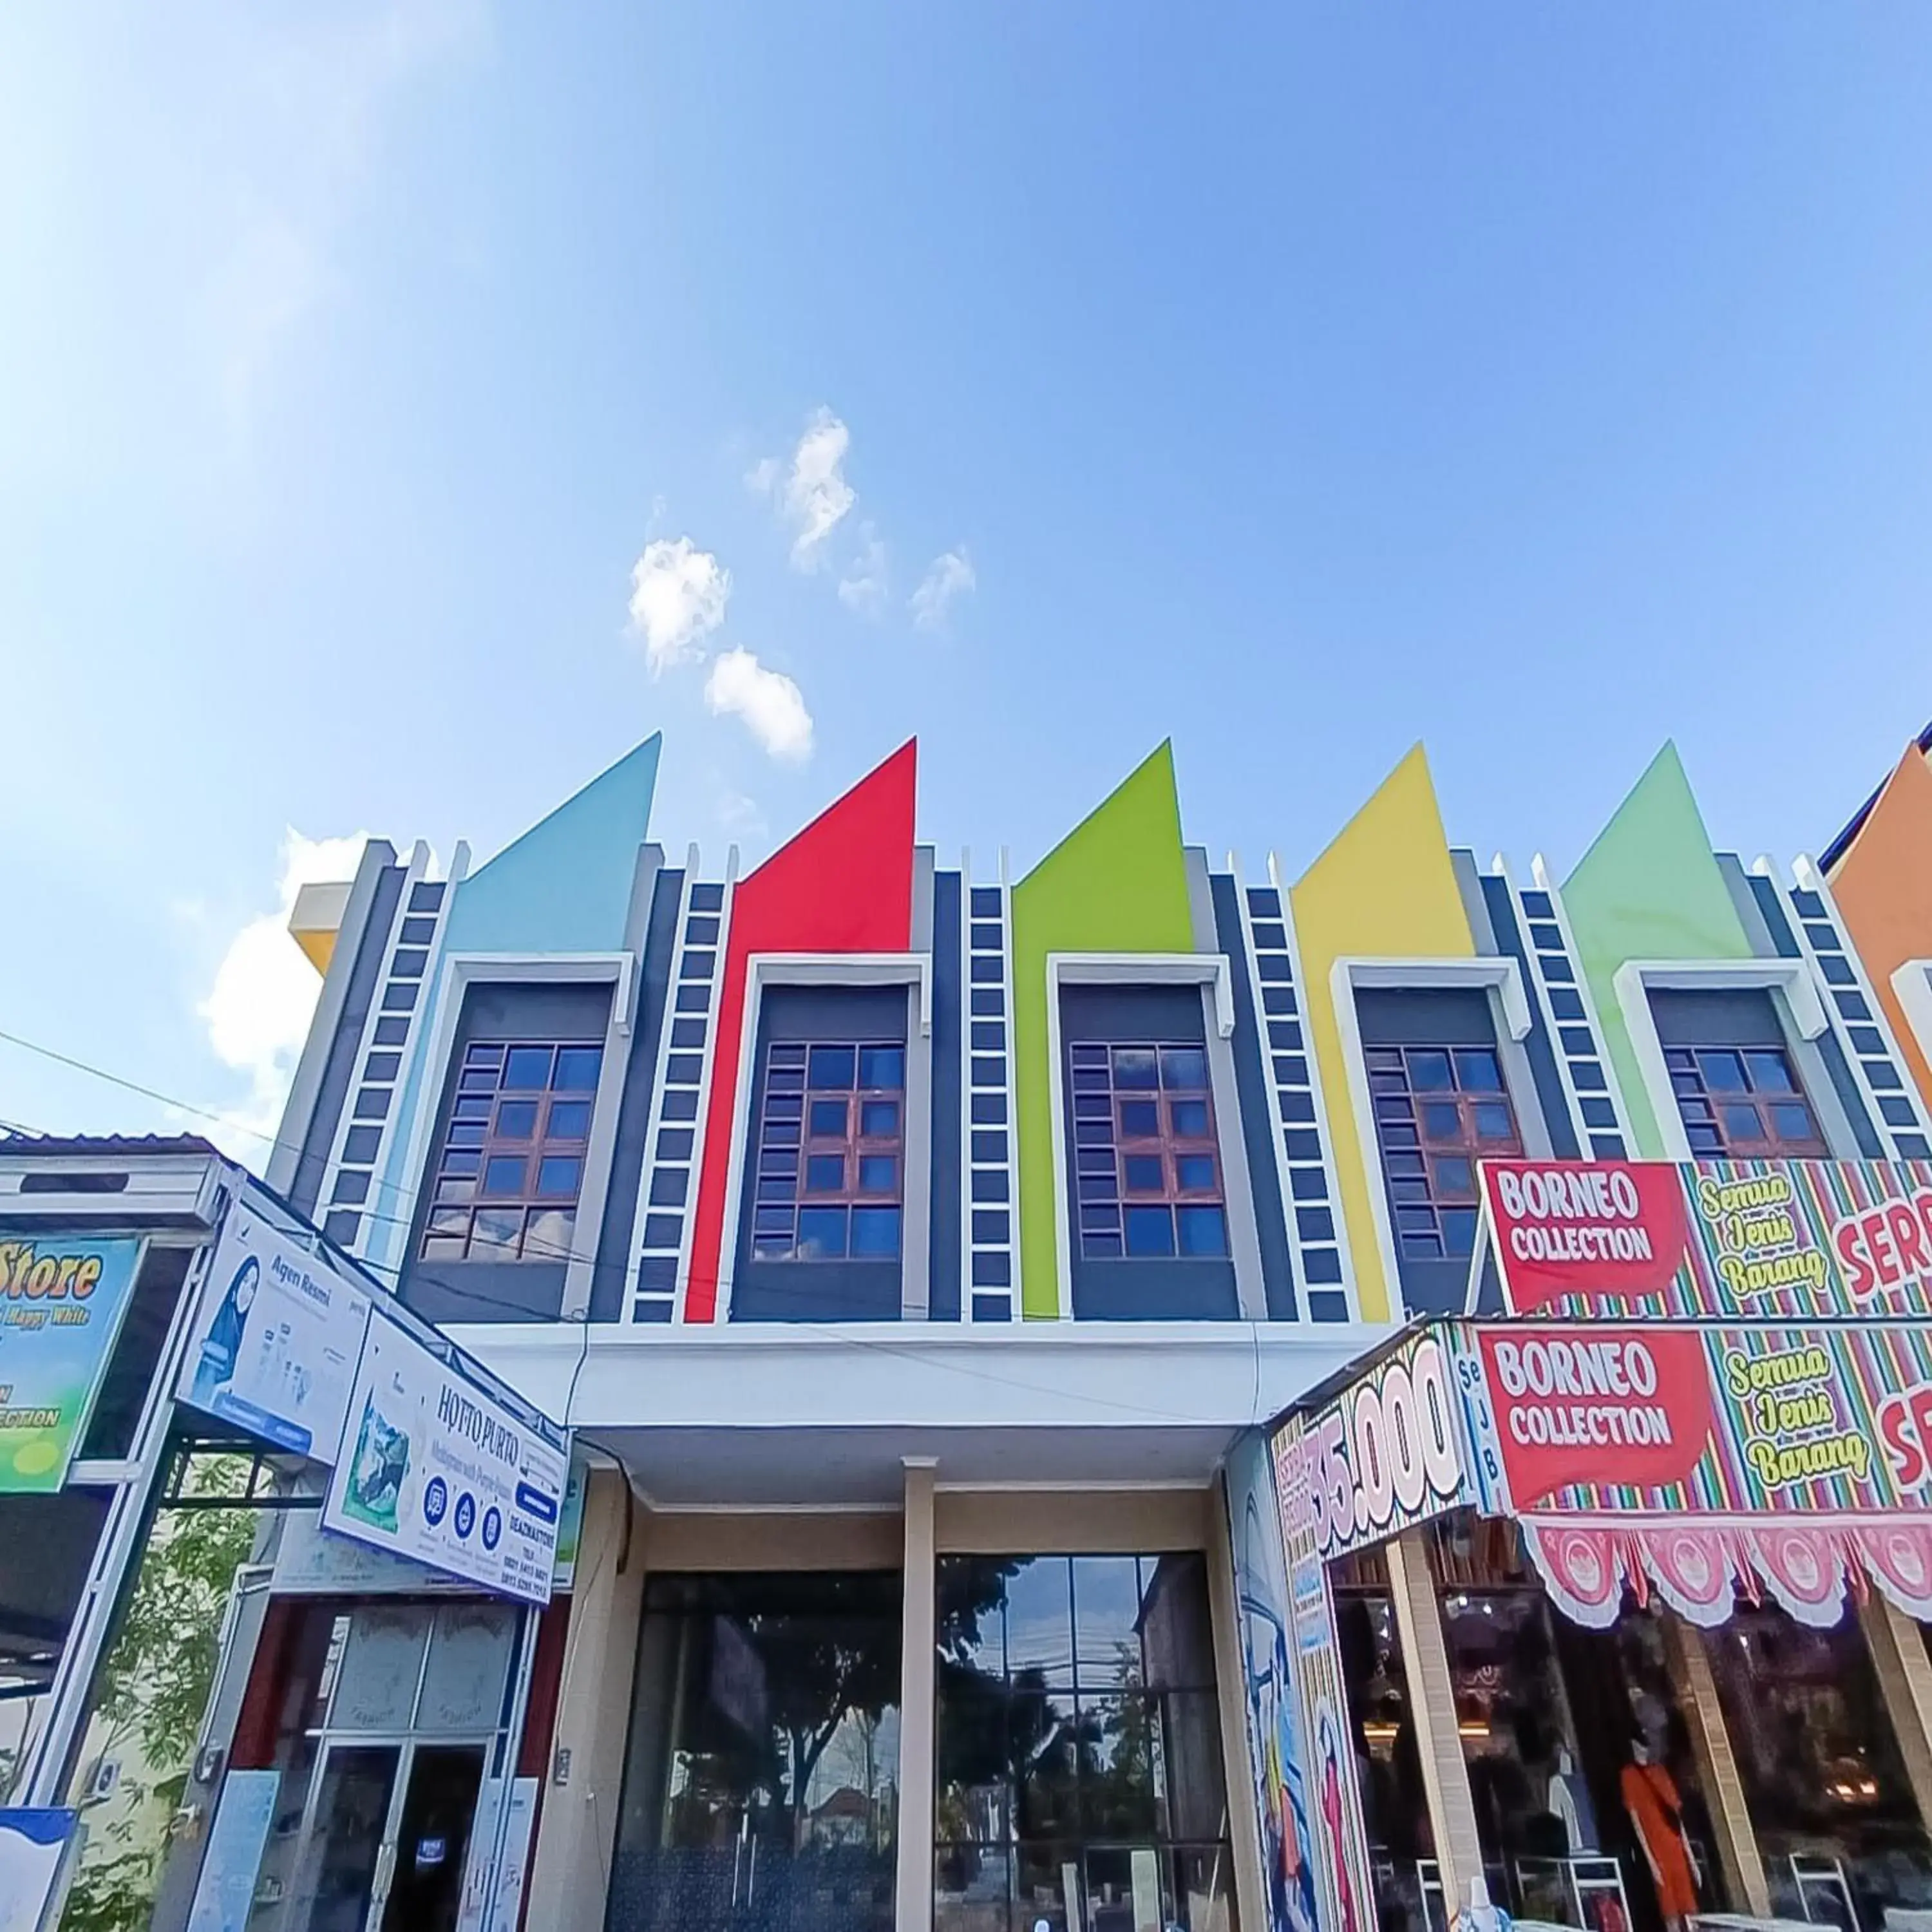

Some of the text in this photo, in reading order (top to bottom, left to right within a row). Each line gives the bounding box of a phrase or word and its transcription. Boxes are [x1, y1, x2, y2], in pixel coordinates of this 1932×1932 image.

[1497, 1170, 1640, 1220] BORNEO
[1700, 1177, 1790, 1218] Semua
[1510, 1226, 1654, 1262] COLLECTION
[1726, 1210, 1795, 1252] Jenis
[0, 1241, 103, 1300] Store
[271, 1255, 332, 1307] Agen Resmi
[1719, 1249, 1826, 1296] Barang
[1493, 1340, 1658, 1397] BORNEO
[1727, 1347, 1831, 1396] Semua
[437, 1383, 483, 1443] HOTTO
[482, 1416, 519, 1467] PURTO
[1510, 1406, 1672, 1445] COLLECTION
[1756, 1387, 1834, 1435] Jenis
[1302, 1336, 1462, 1552] 35.000
[1747, 1432, 1868, 1487] Barang
